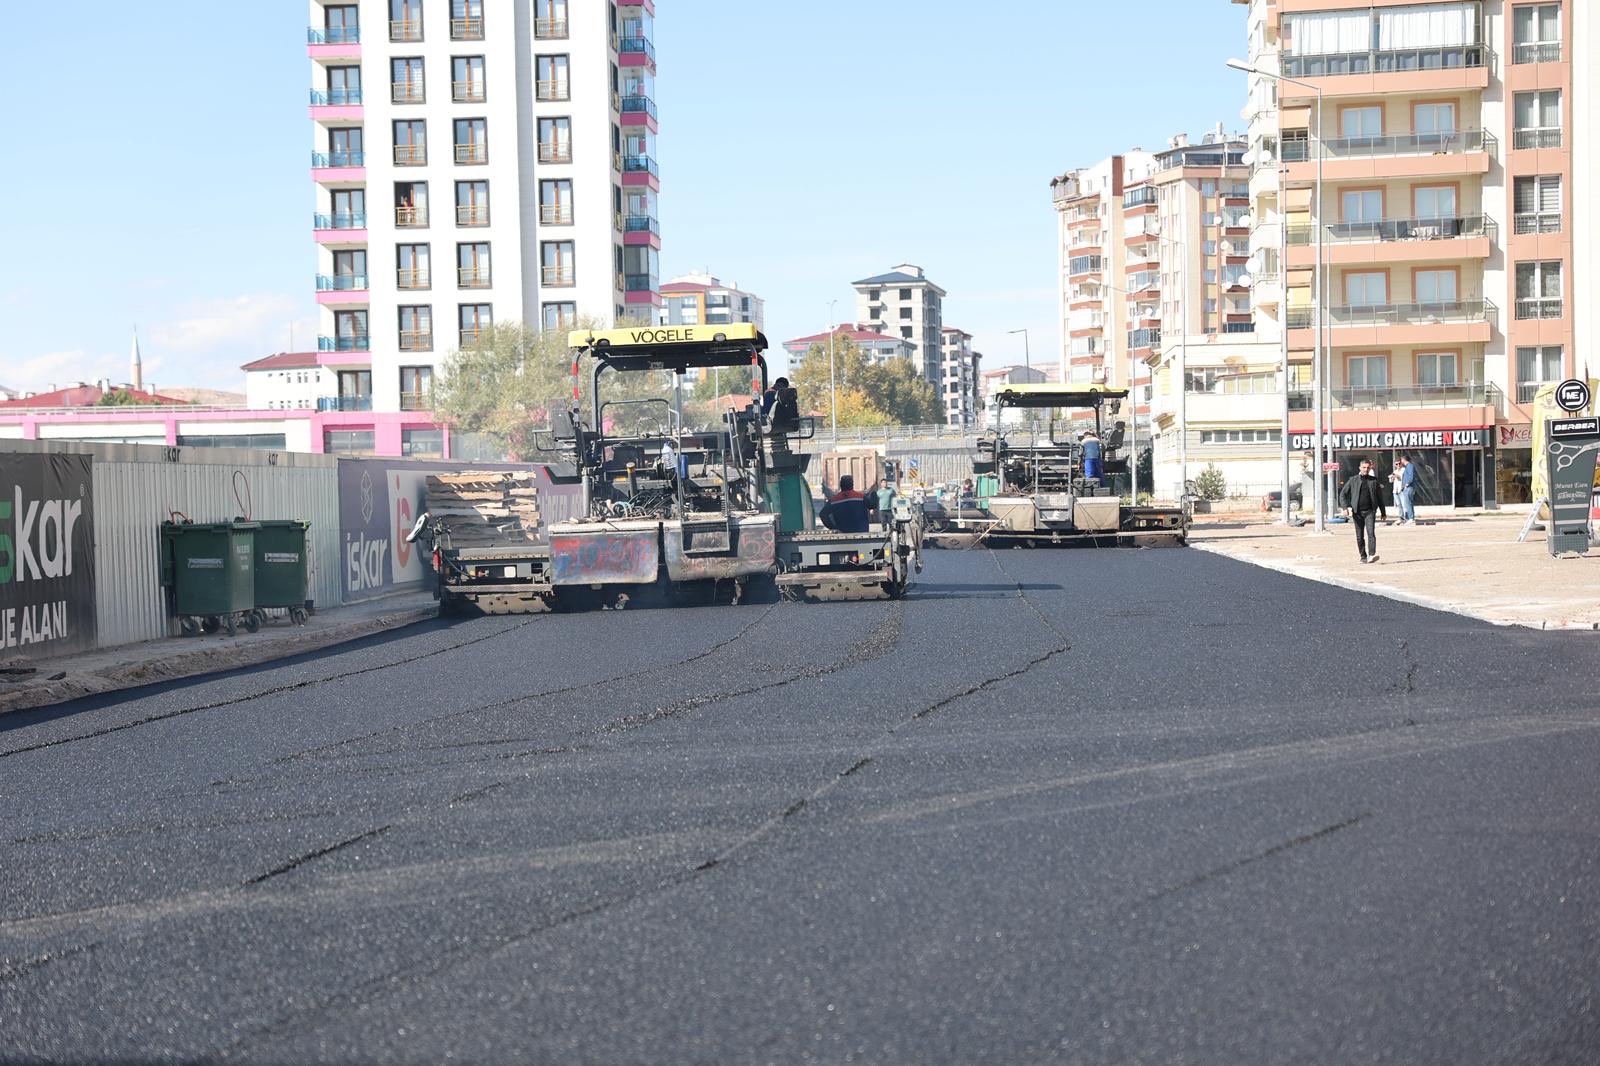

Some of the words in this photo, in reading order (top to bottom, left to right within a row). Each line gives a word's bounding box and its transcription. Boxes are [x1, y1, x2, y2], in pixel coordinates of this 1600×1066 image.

[630, 328, 694, 344] VÖGELE
[1554, 422, 1596, 431] BERBER
[1344, 433, 1380, 451] ÇIDIK
[346, 532, 388, 592] iskar
[20, 600, 68, 646] ALANI
